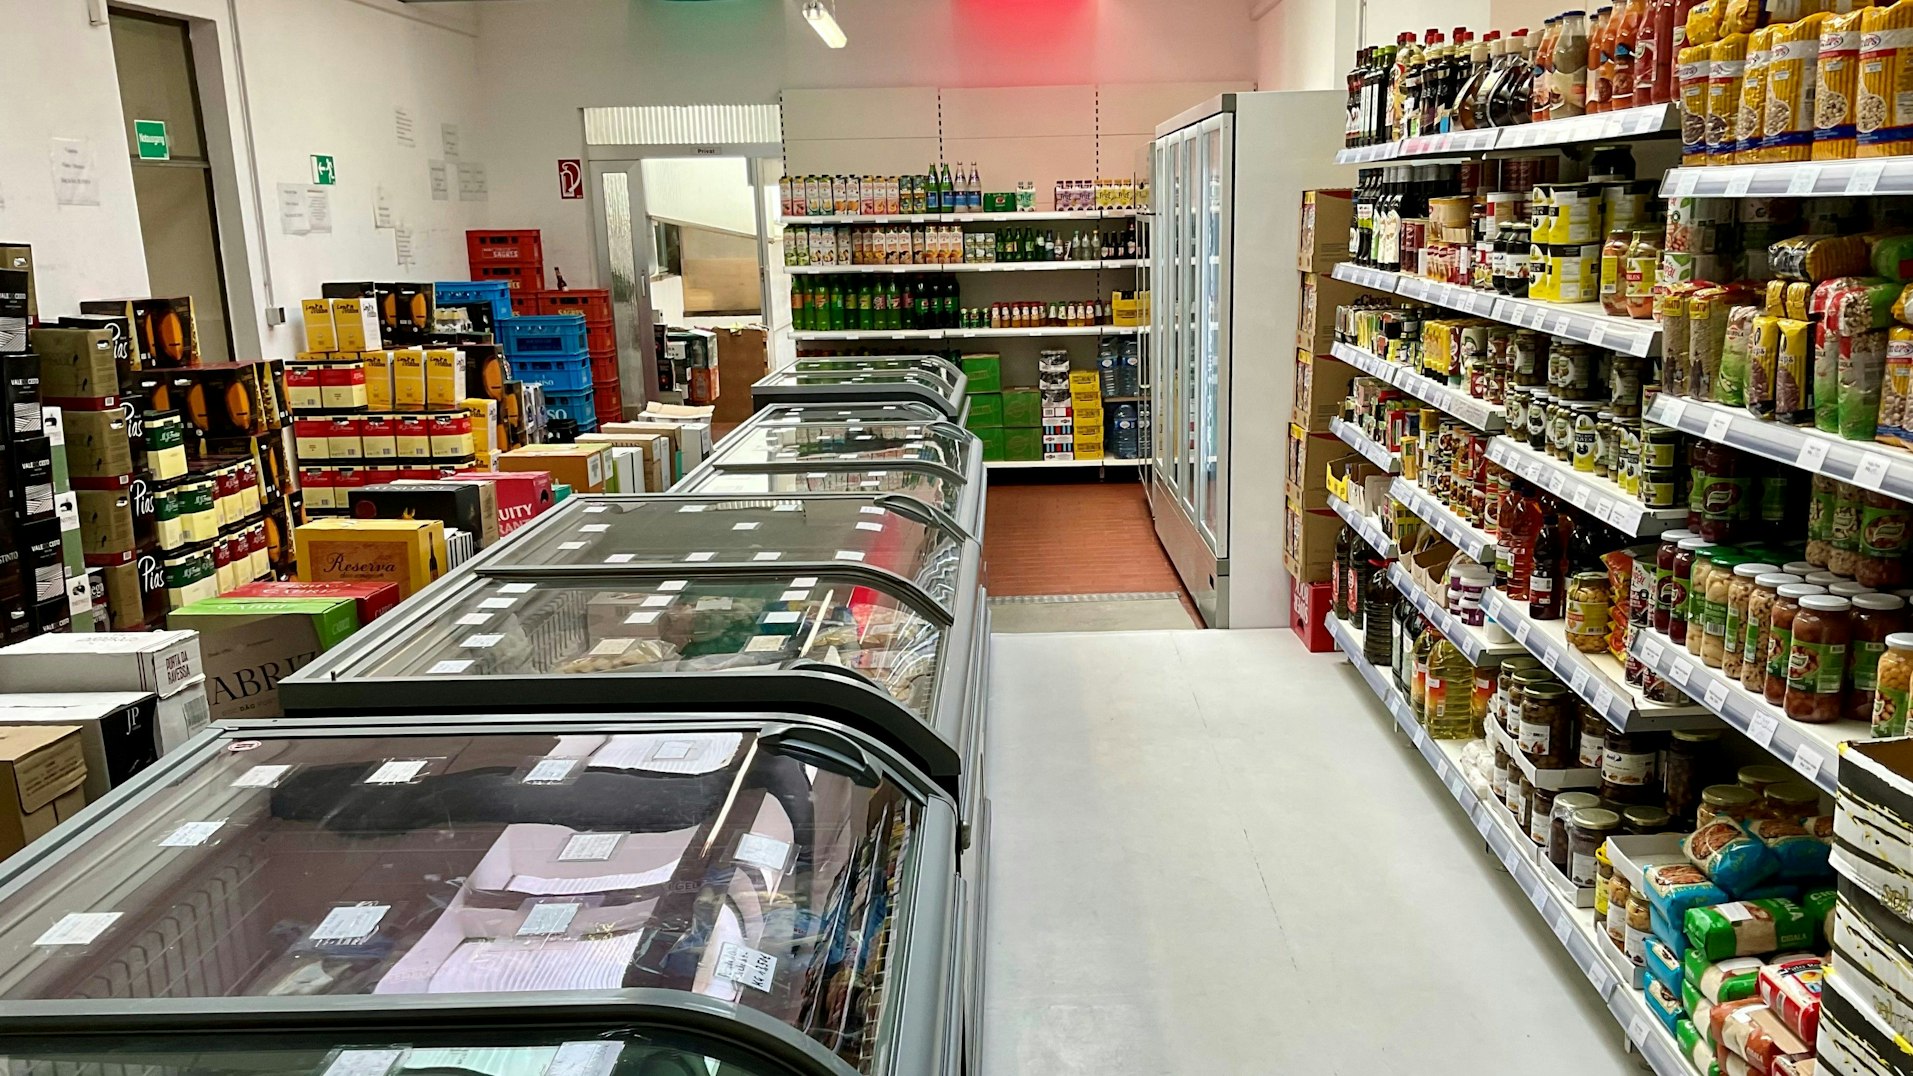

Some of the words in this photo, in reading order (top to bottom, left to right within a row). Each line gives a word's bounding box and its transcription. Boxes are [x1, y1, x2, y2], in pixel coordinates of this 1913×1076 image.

[130, 480, 154, 517] Pias
[138, 555, 164, 593] Pias
[323, 552, 396, 573] Reserva
[165, 653, 181, 669] PORTA
[181, 650, 188, 661] DA
[167, 664, 191, 684] RAVESSA
[126, 706, 140, 735] JP
